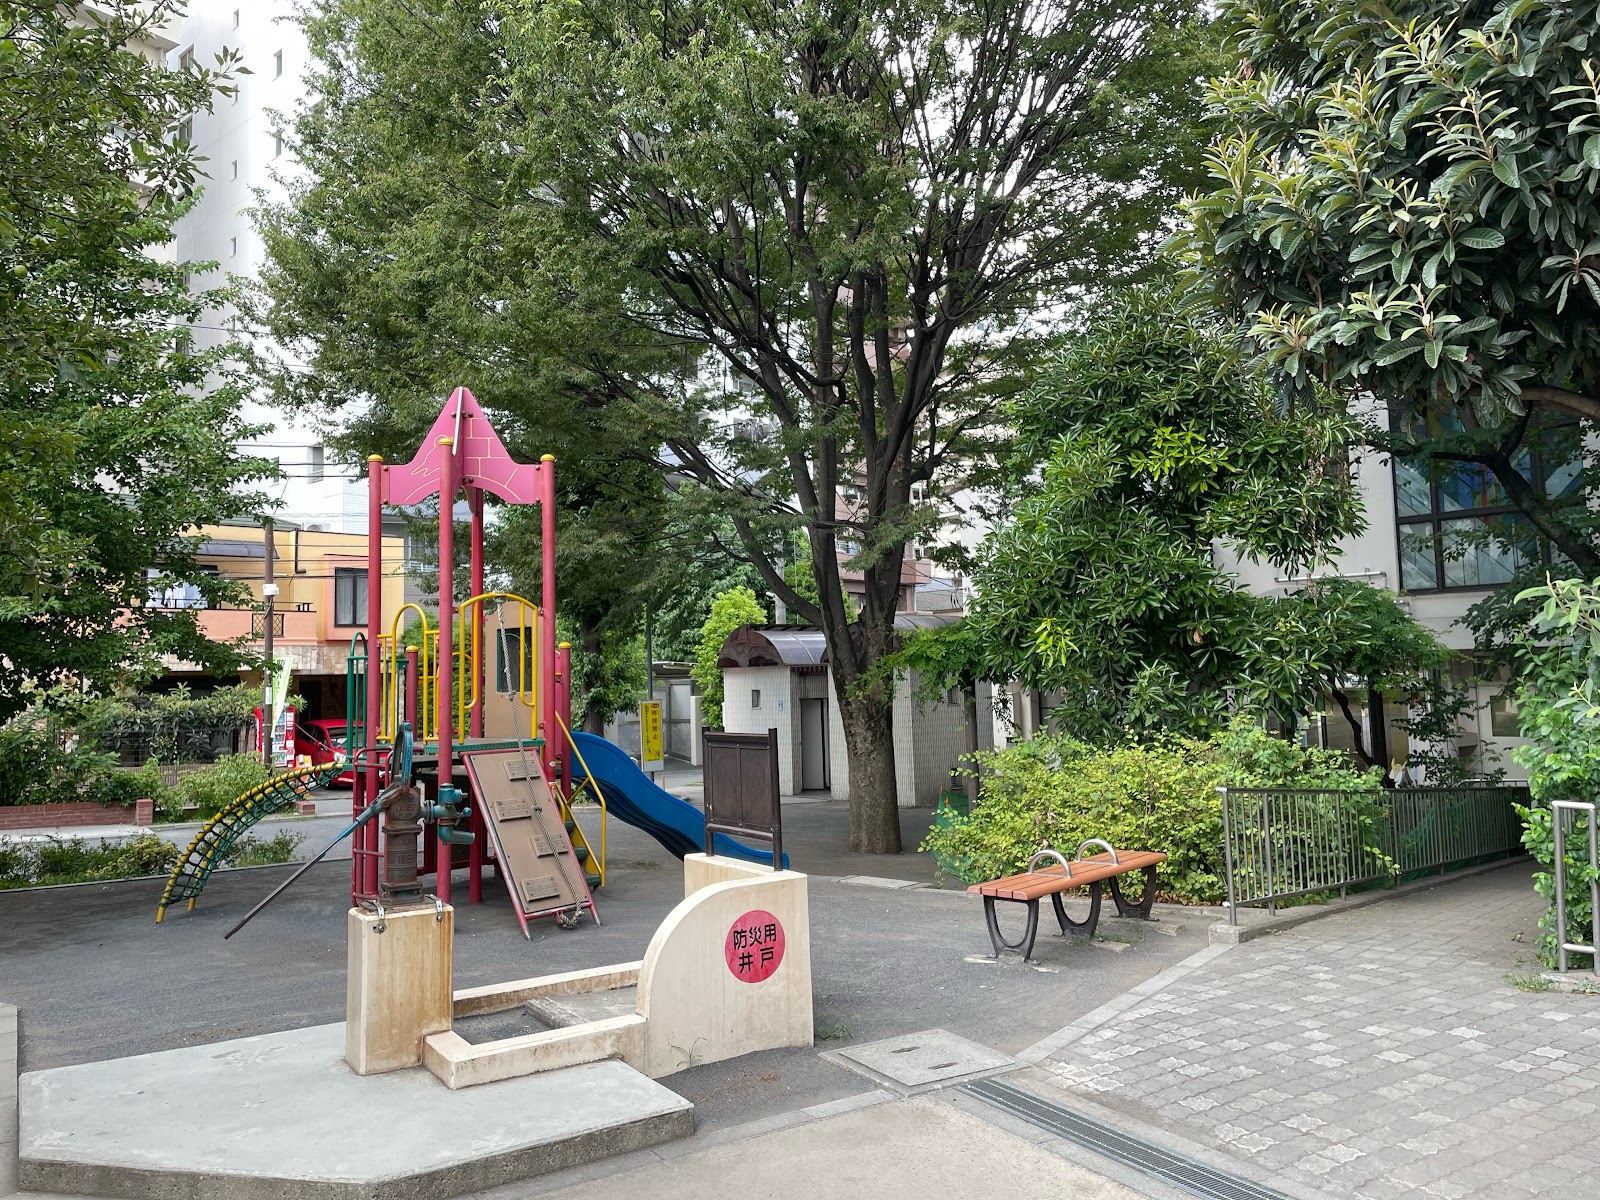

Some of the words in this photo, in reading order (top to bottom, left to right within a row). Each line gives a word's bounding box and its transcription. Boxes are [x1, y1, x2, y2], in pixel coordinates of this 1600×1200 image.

[733, 923, 777, 950] 防災用
[738, 946, 775, 974] 井戸
